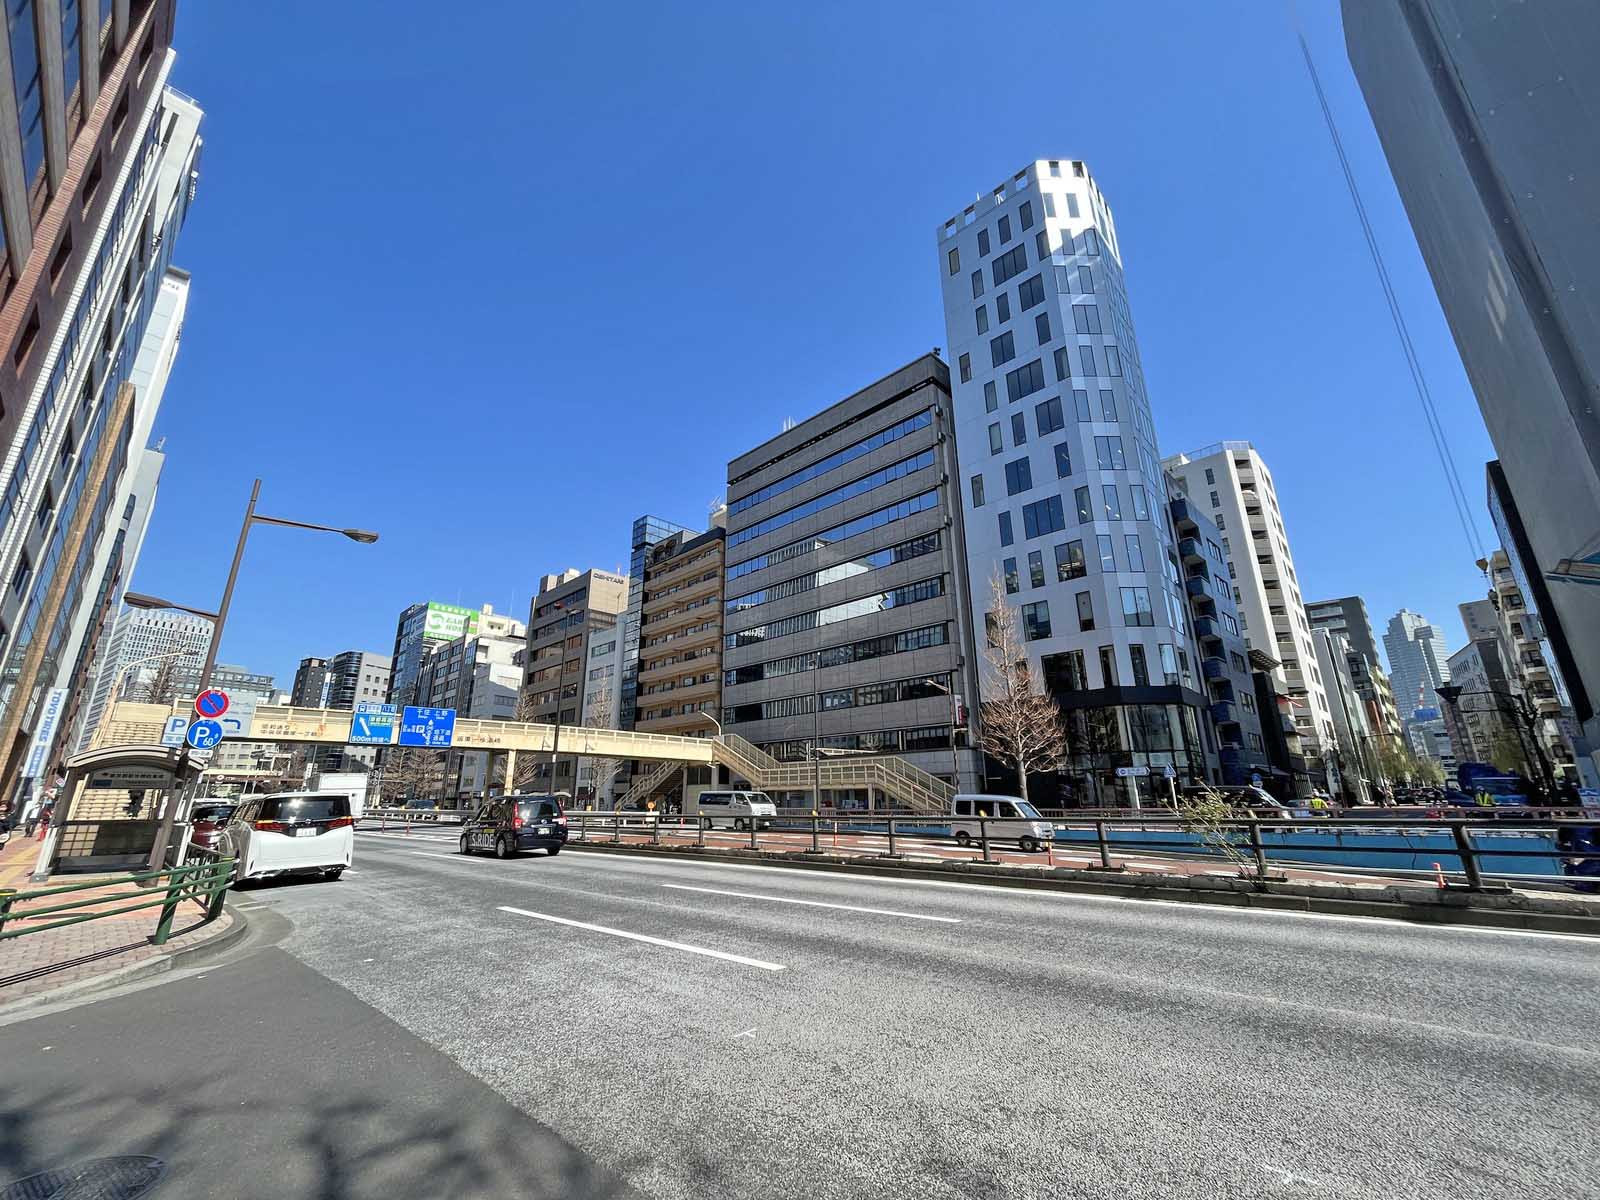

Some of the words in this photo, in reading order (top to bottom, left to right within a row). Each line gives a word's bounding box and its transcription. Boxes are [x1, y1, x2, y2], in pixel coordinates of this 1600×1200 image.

[170, 719, 186, 732] P
[193, 726, 210, 746] P
[471, 833, 495, 848] S.RIDE
